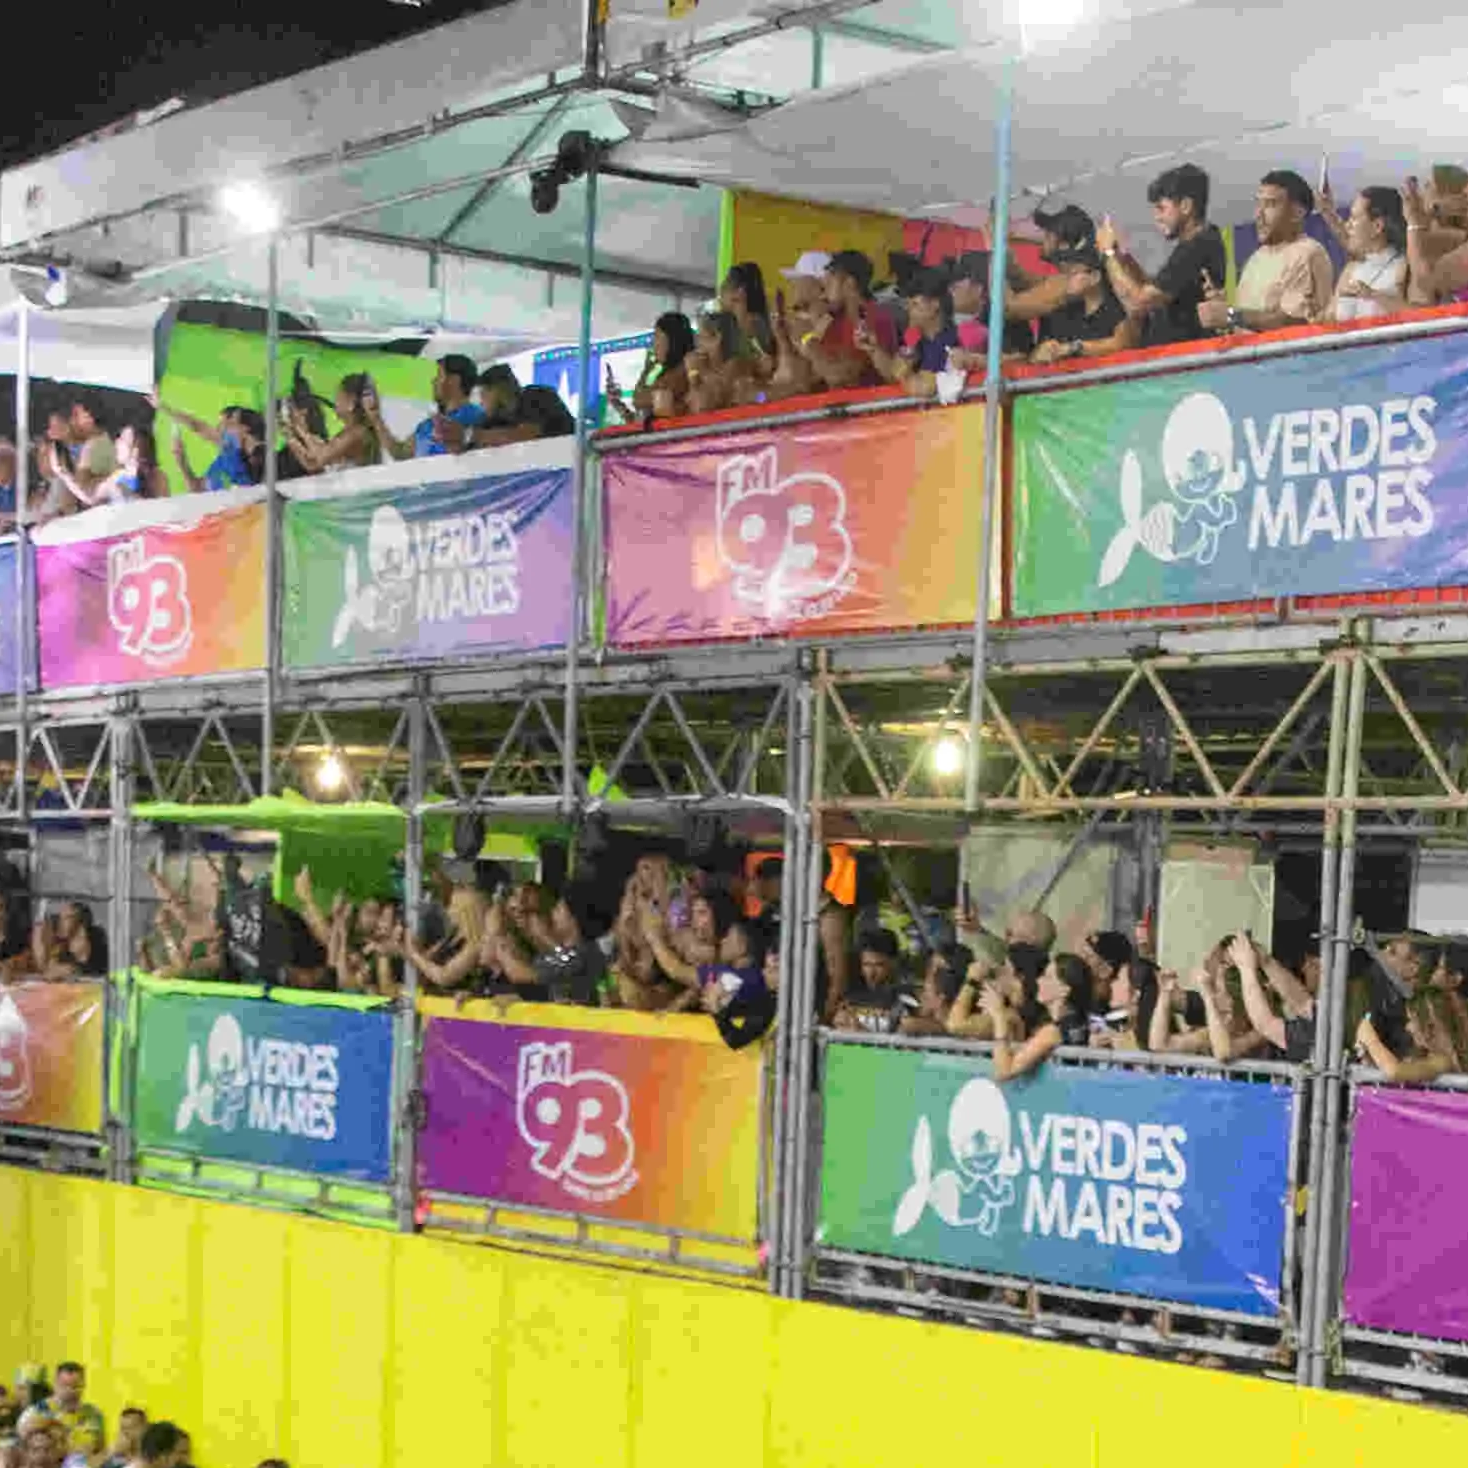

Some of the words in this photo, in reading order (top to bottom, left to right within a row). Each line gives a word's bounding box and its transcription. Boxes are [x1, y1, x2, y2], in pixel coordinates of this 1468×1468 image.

[1242, 395, 1438, 480] VERDES
[409, 509, 519, 572] VERDES
[716, 472, 853, 608] 93
[1247, 466, 1435, 551] MARES
[108, 555, 191, 656] 93
[415, 563, 519, 623] MARES
[246, 1036, 339, 1092] VERDES
[519, 1041, 573, 1090] FM
[249, 1084, 337, 1141] MARES
[516, 1070, 636, 1181] 93
[1018, 1109, 1188, 1190] VERDES
[1023, 1173, 1184, 1255] MARES
